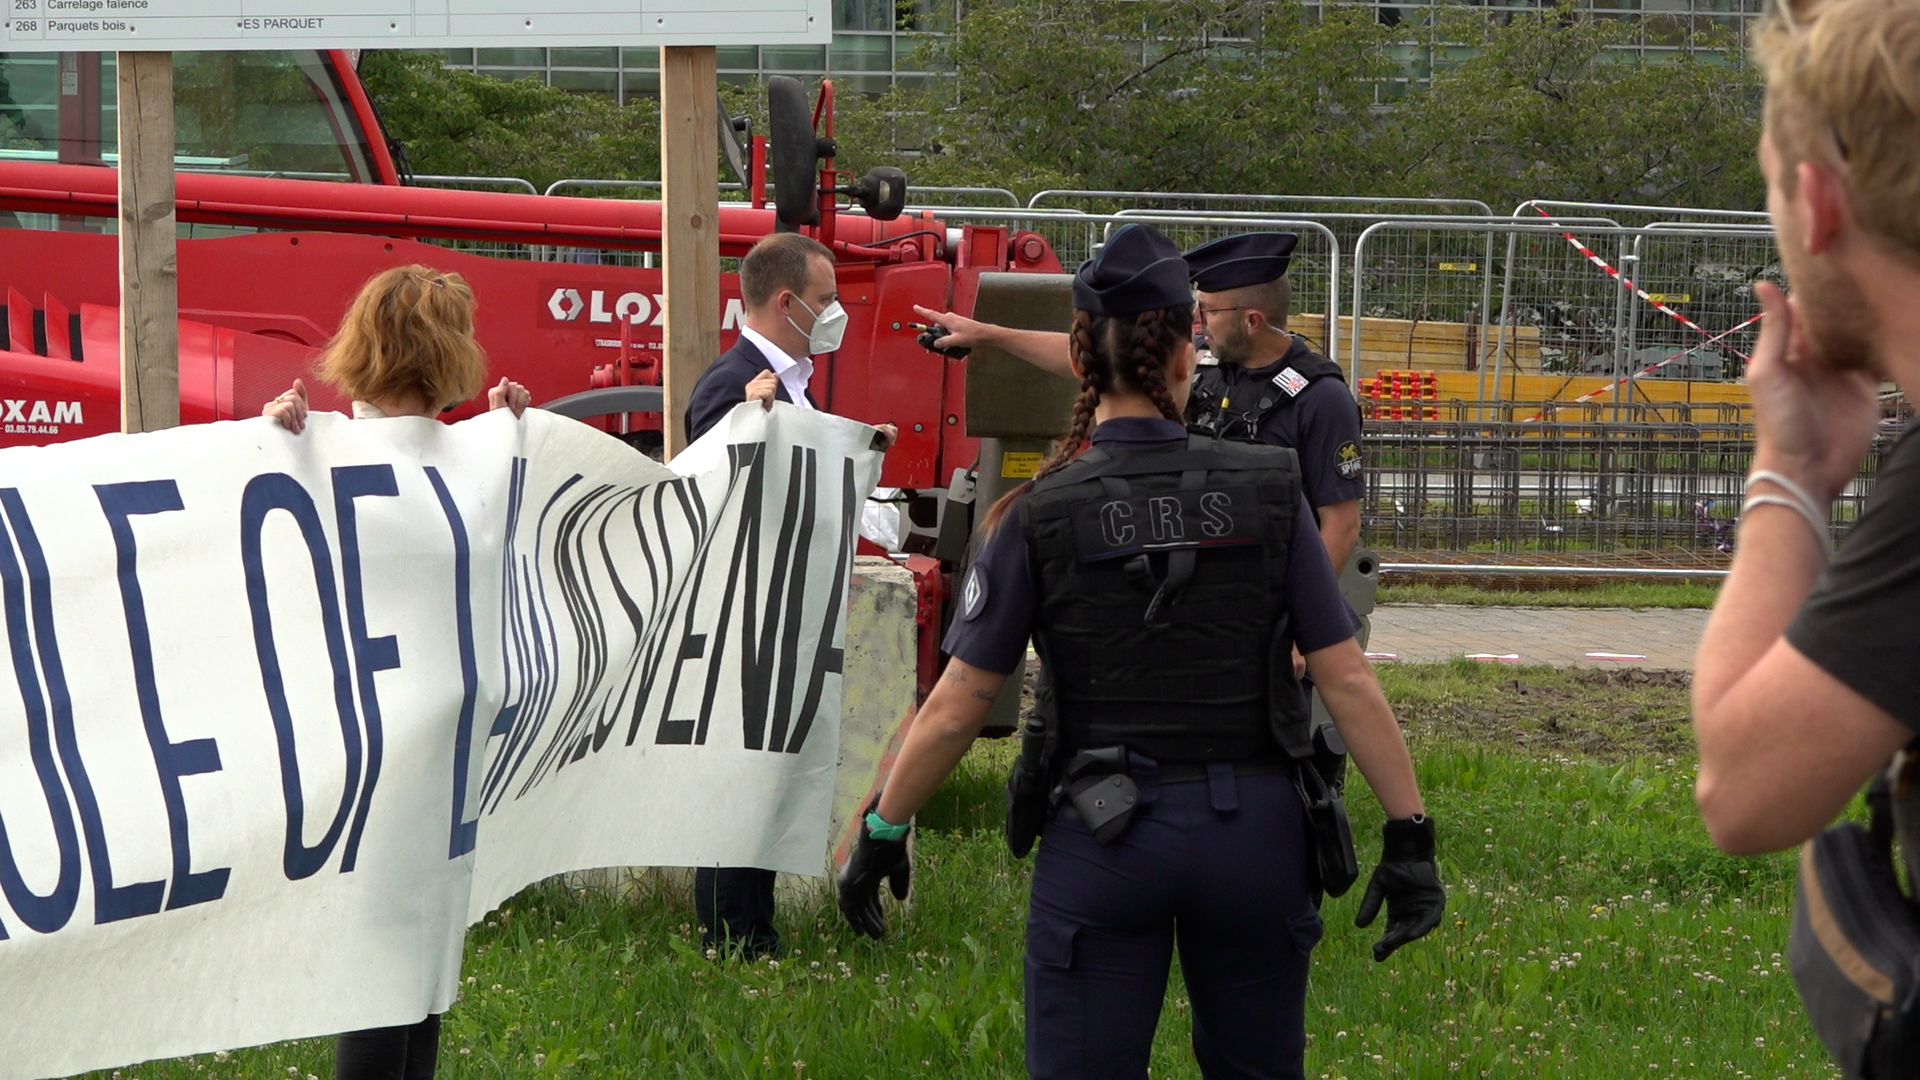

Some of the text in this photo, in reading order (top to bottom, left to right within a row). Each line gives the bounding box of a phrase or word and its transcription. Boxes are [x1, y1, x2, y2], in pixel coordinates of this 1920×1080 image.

[15, 0, 37, 10] 263
[47, 0, 103, 11] Carrelage
[15, 21, 38, 32] 268
[48, 20, 126, 33] Parquets bois
[243, 18, 324, 29] ES PARQUET
[0, 399, 84, 425] XAM
[0, 478, 232, 940] ULE
[240, 463, 402, 881] OF
